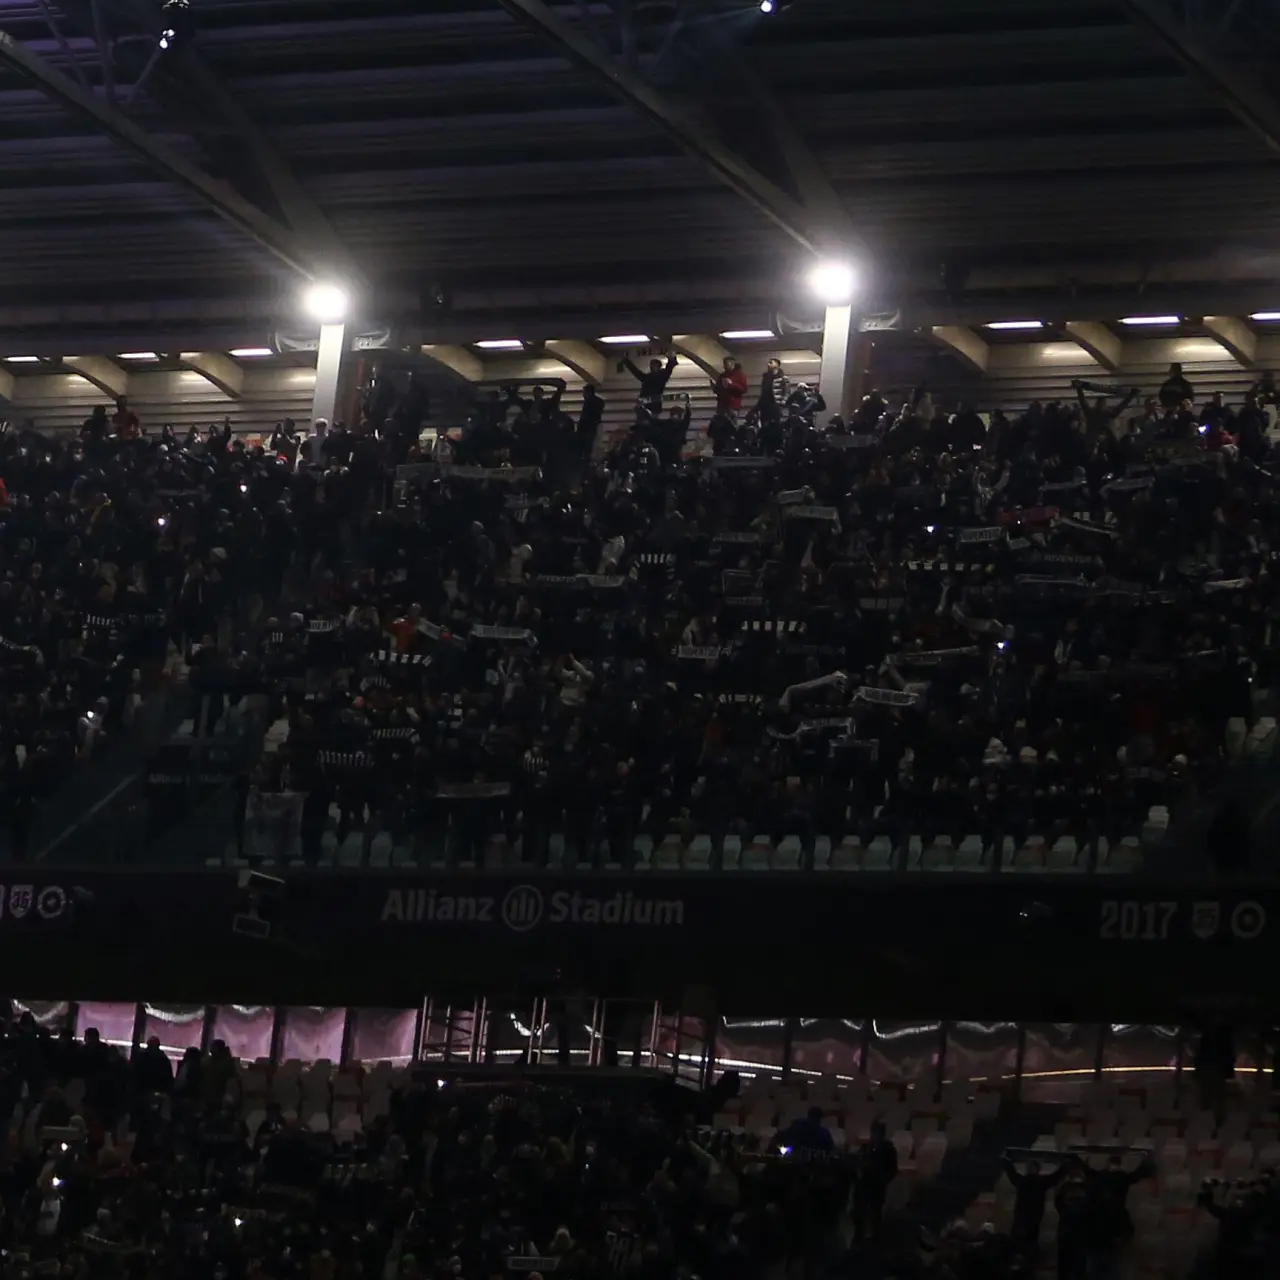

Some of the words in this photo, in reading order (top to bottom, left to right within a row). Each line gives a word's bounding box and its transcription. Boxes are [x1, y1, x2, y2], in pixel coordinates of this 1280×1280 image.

[379, 888, 495, 922] Allianz
[548, 890, 685, 925] Stadium
[1099, 900, 1178, 940] 2017
